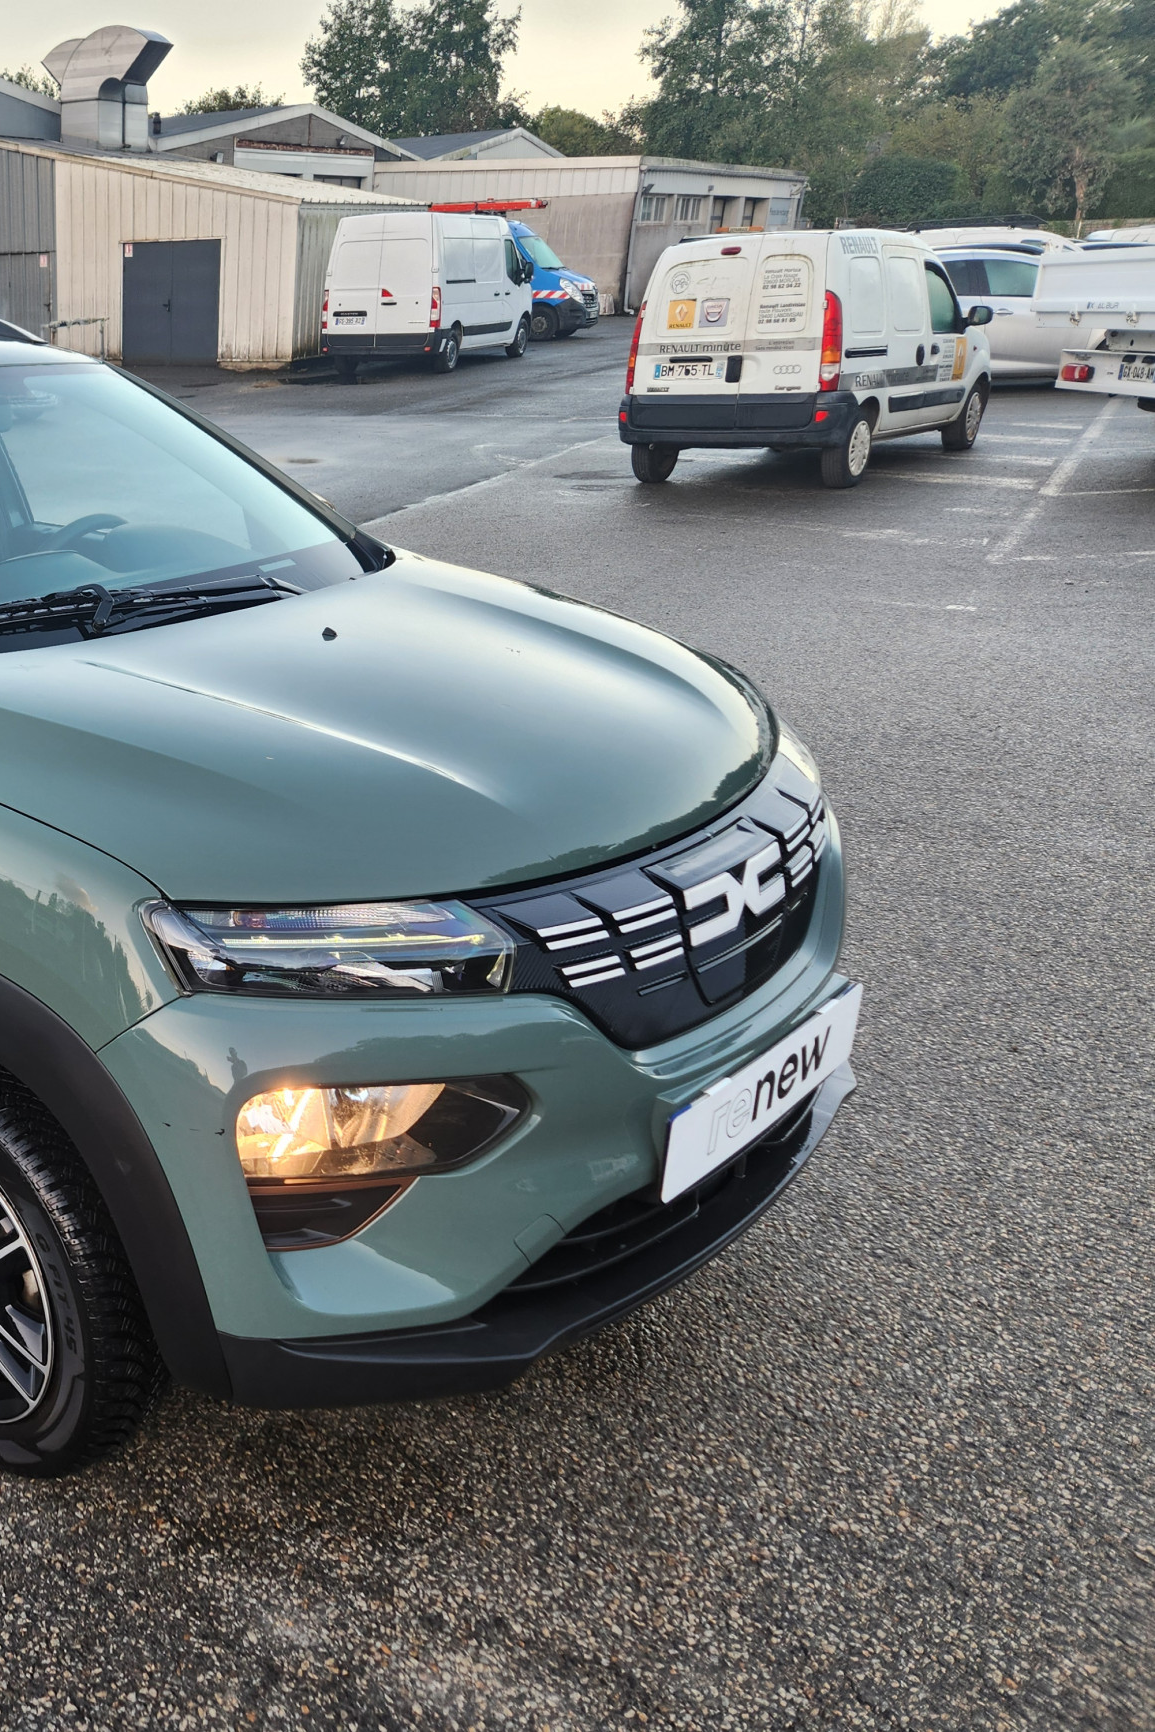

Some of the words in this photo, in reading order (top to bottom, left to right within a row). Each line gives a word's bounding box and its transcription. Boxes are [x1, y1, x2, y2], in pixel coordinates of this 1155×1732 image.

[839, 236, 878, 254] RENAULT
[659, 343, 700, 354] RENAULT
[707, 1025, 832, 1156] renew
[47, 1262, 71, 1310] FIT
